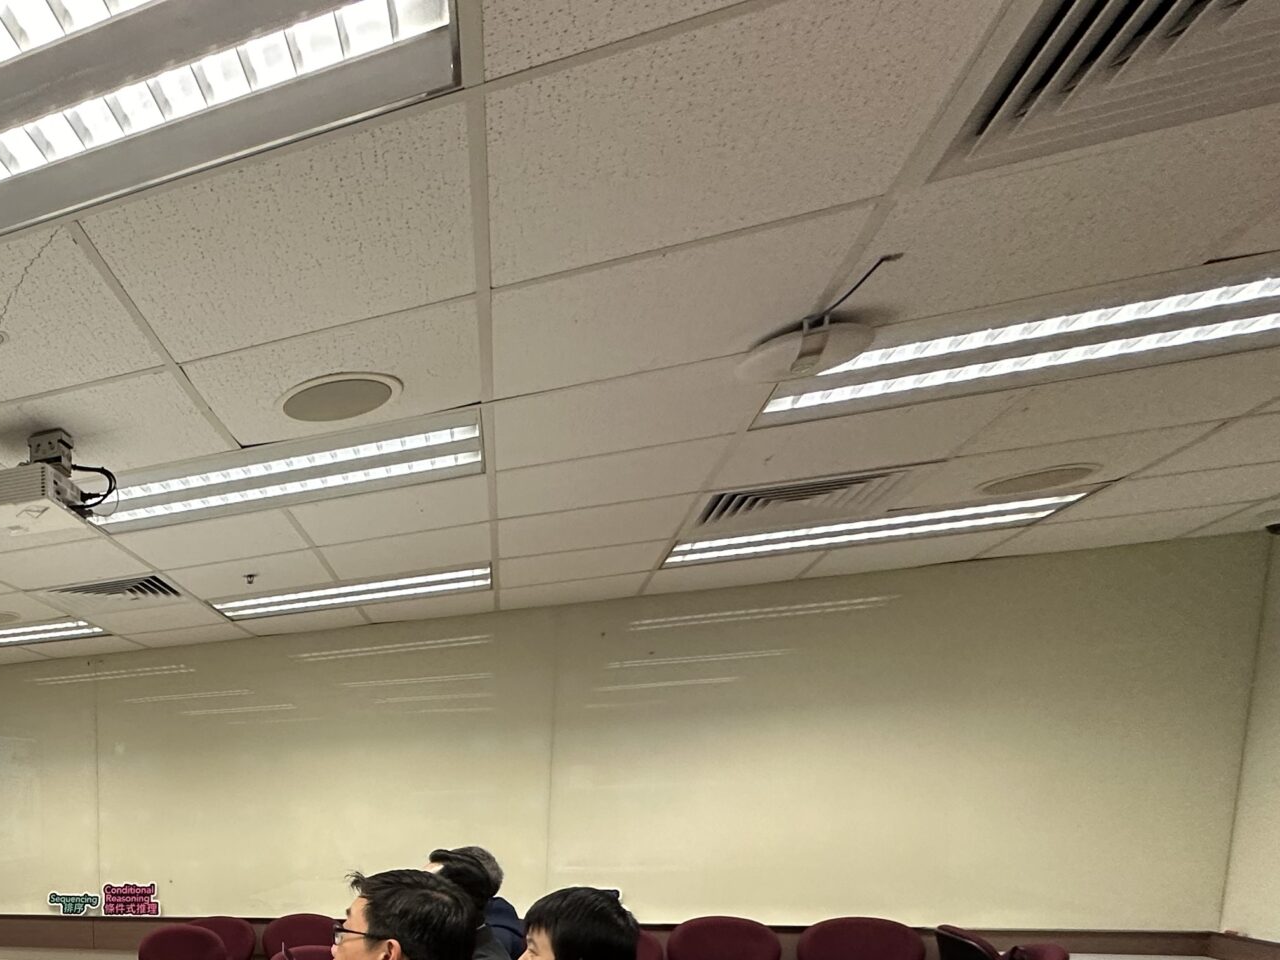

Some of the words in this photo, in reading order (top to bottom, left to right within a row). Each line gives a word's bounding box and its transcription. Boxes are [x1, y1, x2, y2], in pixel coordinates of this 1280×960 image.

[104, 885, 155, 895] Conditional
[50, 894, 98, 905] Sequencing
[105, 894, 150, 903] Reasoning
[64, 903, 84, 913] 排序
